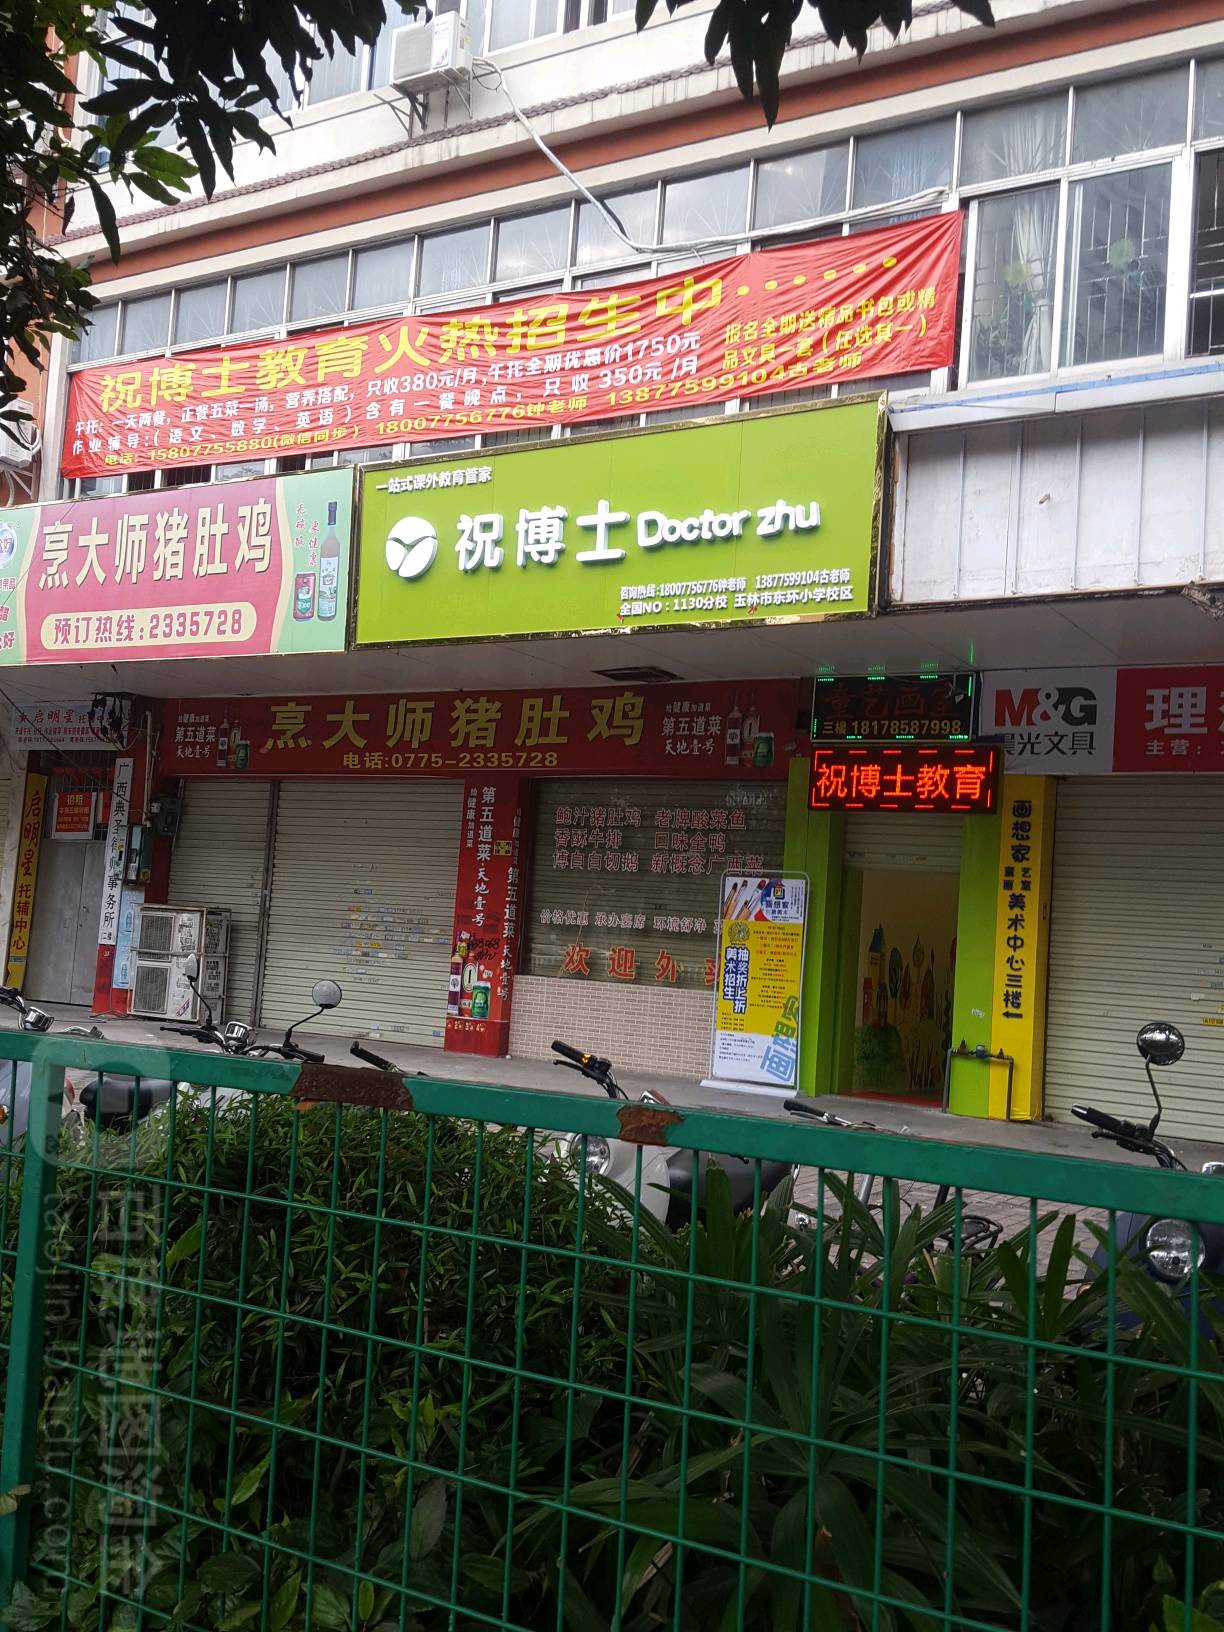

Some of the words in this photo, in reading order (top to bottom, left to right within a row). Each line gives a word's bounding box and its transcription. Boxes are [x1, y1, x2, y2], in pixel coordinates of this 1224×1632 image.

[375, 466, 492, 495] 一站式课外教育管家
[38, 497, 273, 591] 烹大师猪肚鸡
[455, 499, 631, 573] 祝博士
[636, 508, 752, 549] Doctor
[756, 499, 821, 537] zhu
[620, 577, 746, 600] 咨询热线:18007756776钟老师
[755, 568, 851, 589] 13877599104古老师
[733, 585, 854, 609] 玉林市东环小学校区
[53, 608, 243, 645] 预订热线:2335728
[260, 691, 645, 754] 烹大师猪肚鸡
[994, 686, 1097, 728] M&G
[1144, 686, 1224, 735] 理
[175, 725, 217, 743] 第五道菜
[660, 715, 722, 737] 第五道菜
[851, 719, 961, 736] 18178587998
[343, 751, 559, 769] 电话:0775-2335728
[664, 739, 716, 756] 天地壹号
[816, 762, 987, 800] 祝博士教育
[1003, 892, 1027, 1010] 美术中心三楼
